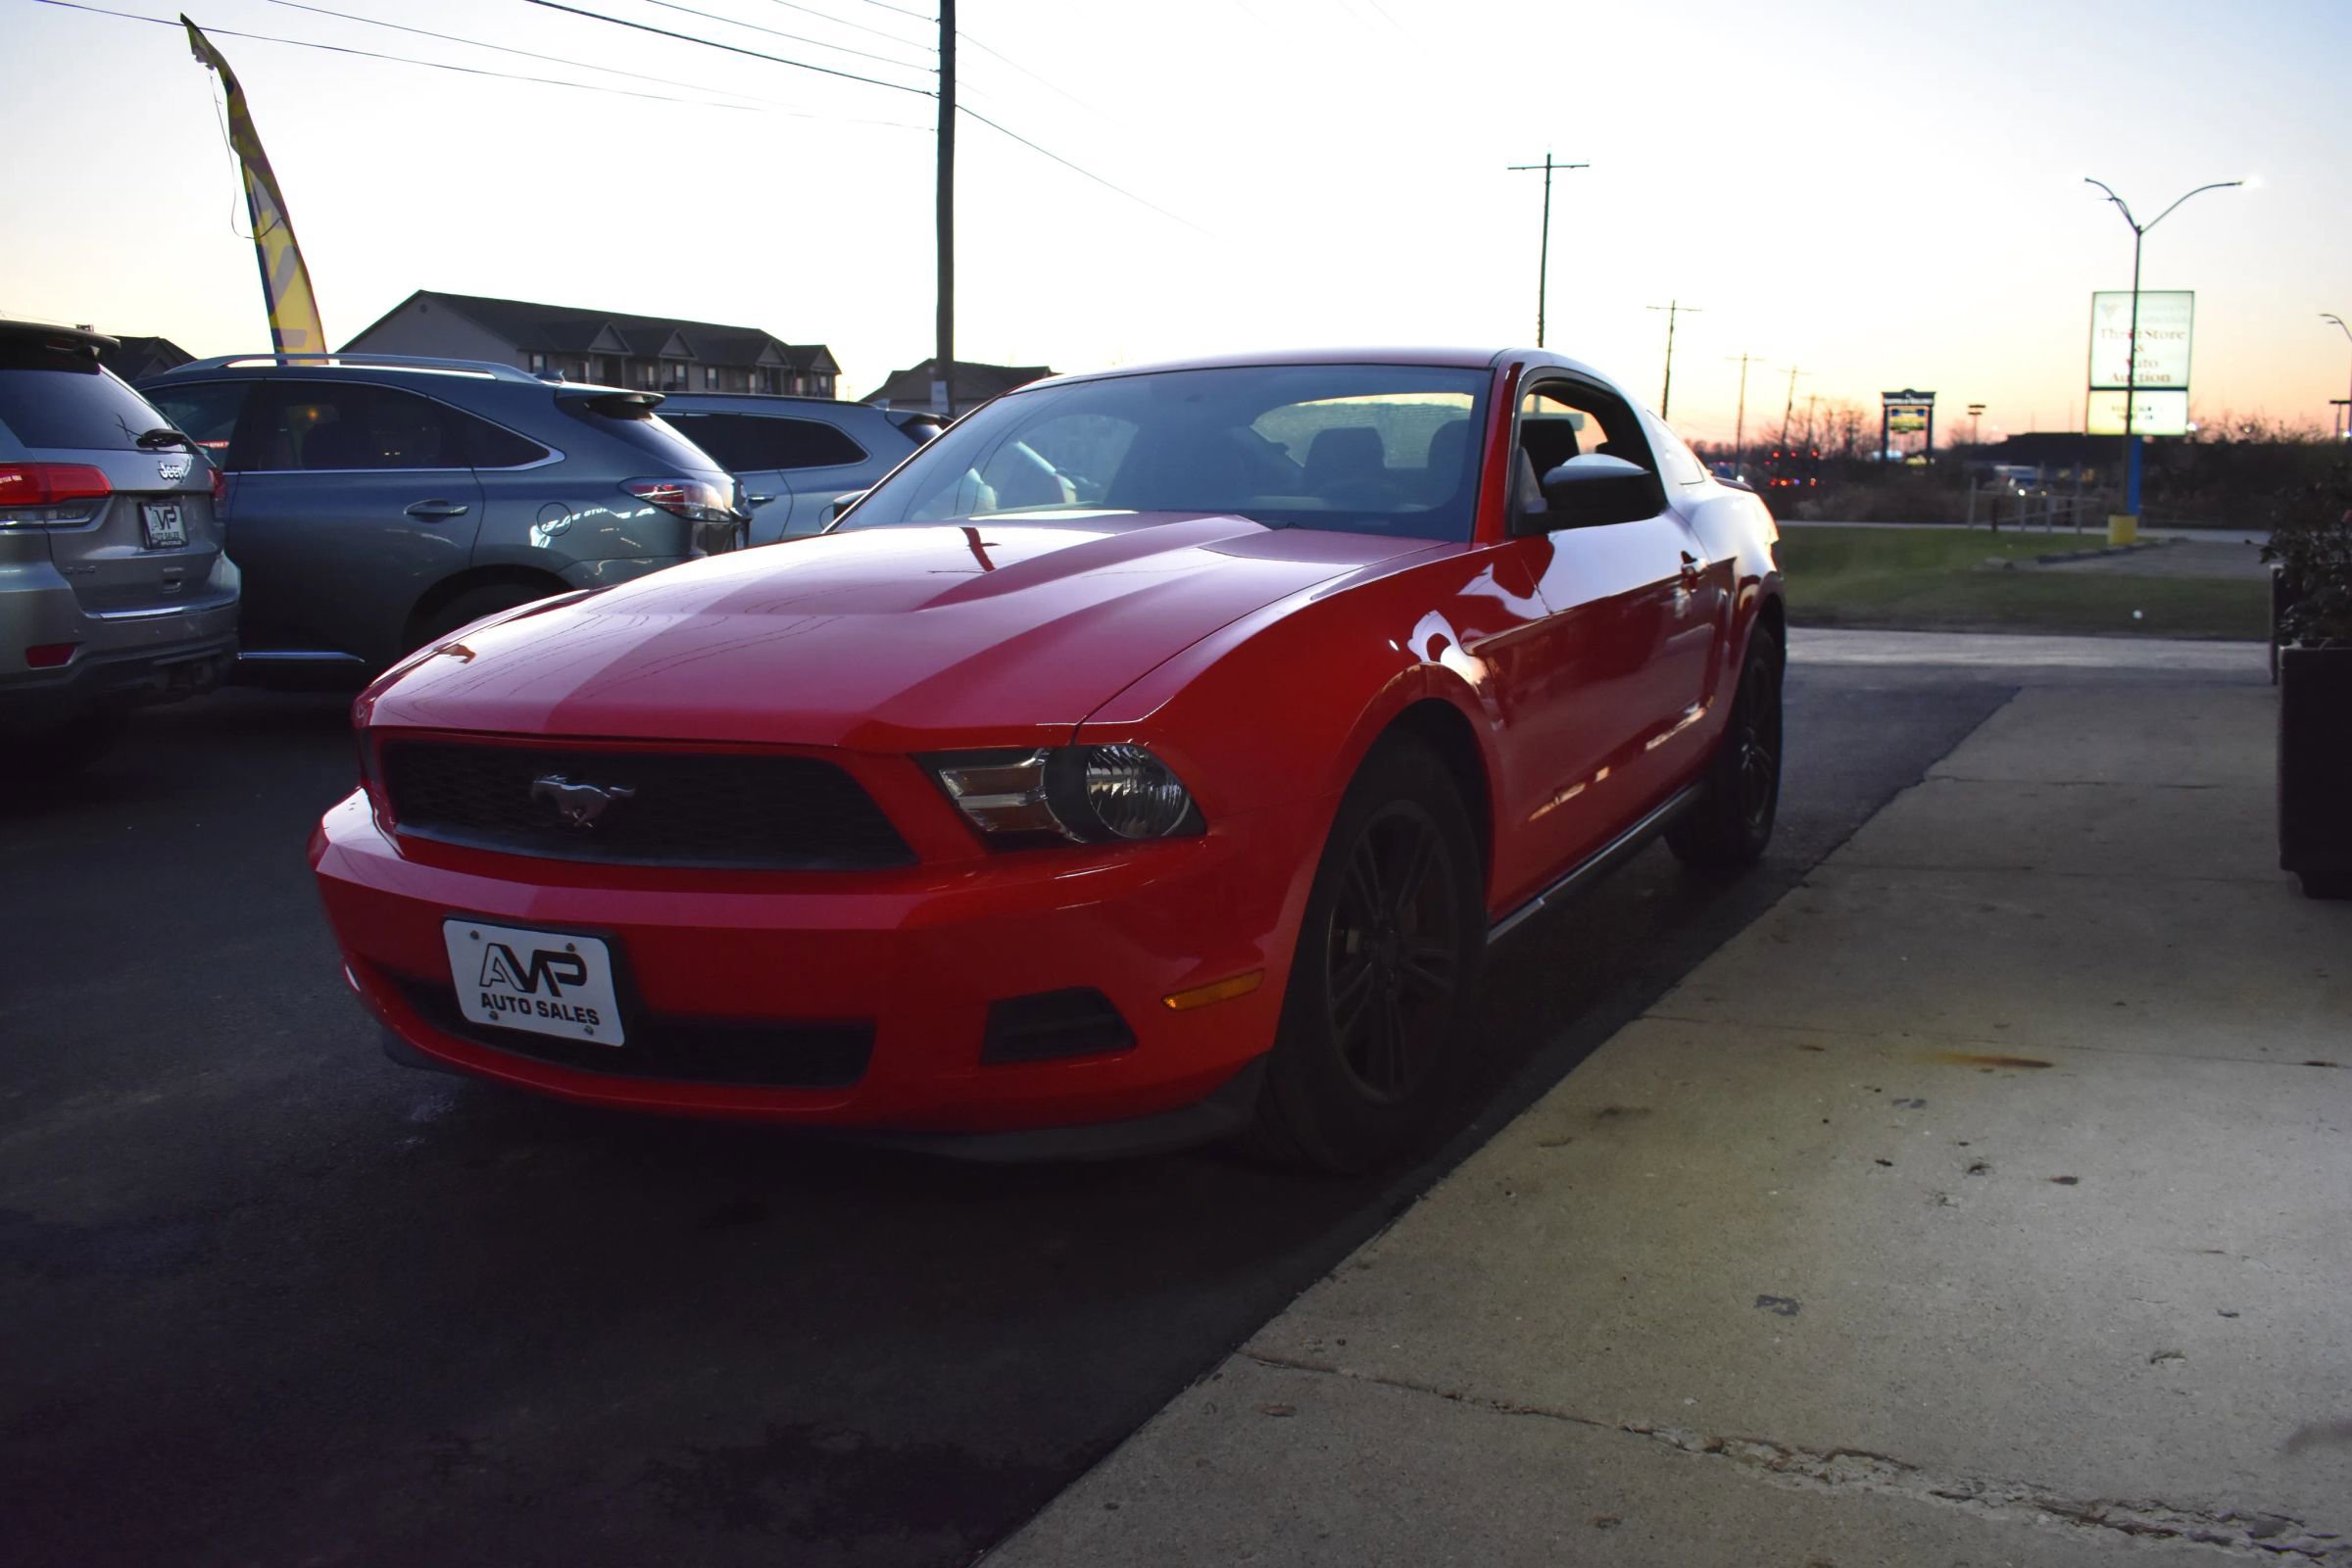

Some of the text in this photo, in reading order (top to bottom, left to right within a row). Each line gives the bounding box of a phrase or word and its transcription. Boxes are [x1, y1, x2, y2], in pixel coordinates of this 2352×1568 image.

[2145, 328, 2186, 340] Store
[158, 460, 184, 483] Jeep
[480, 993, 601, 1026] AUTO SALES
